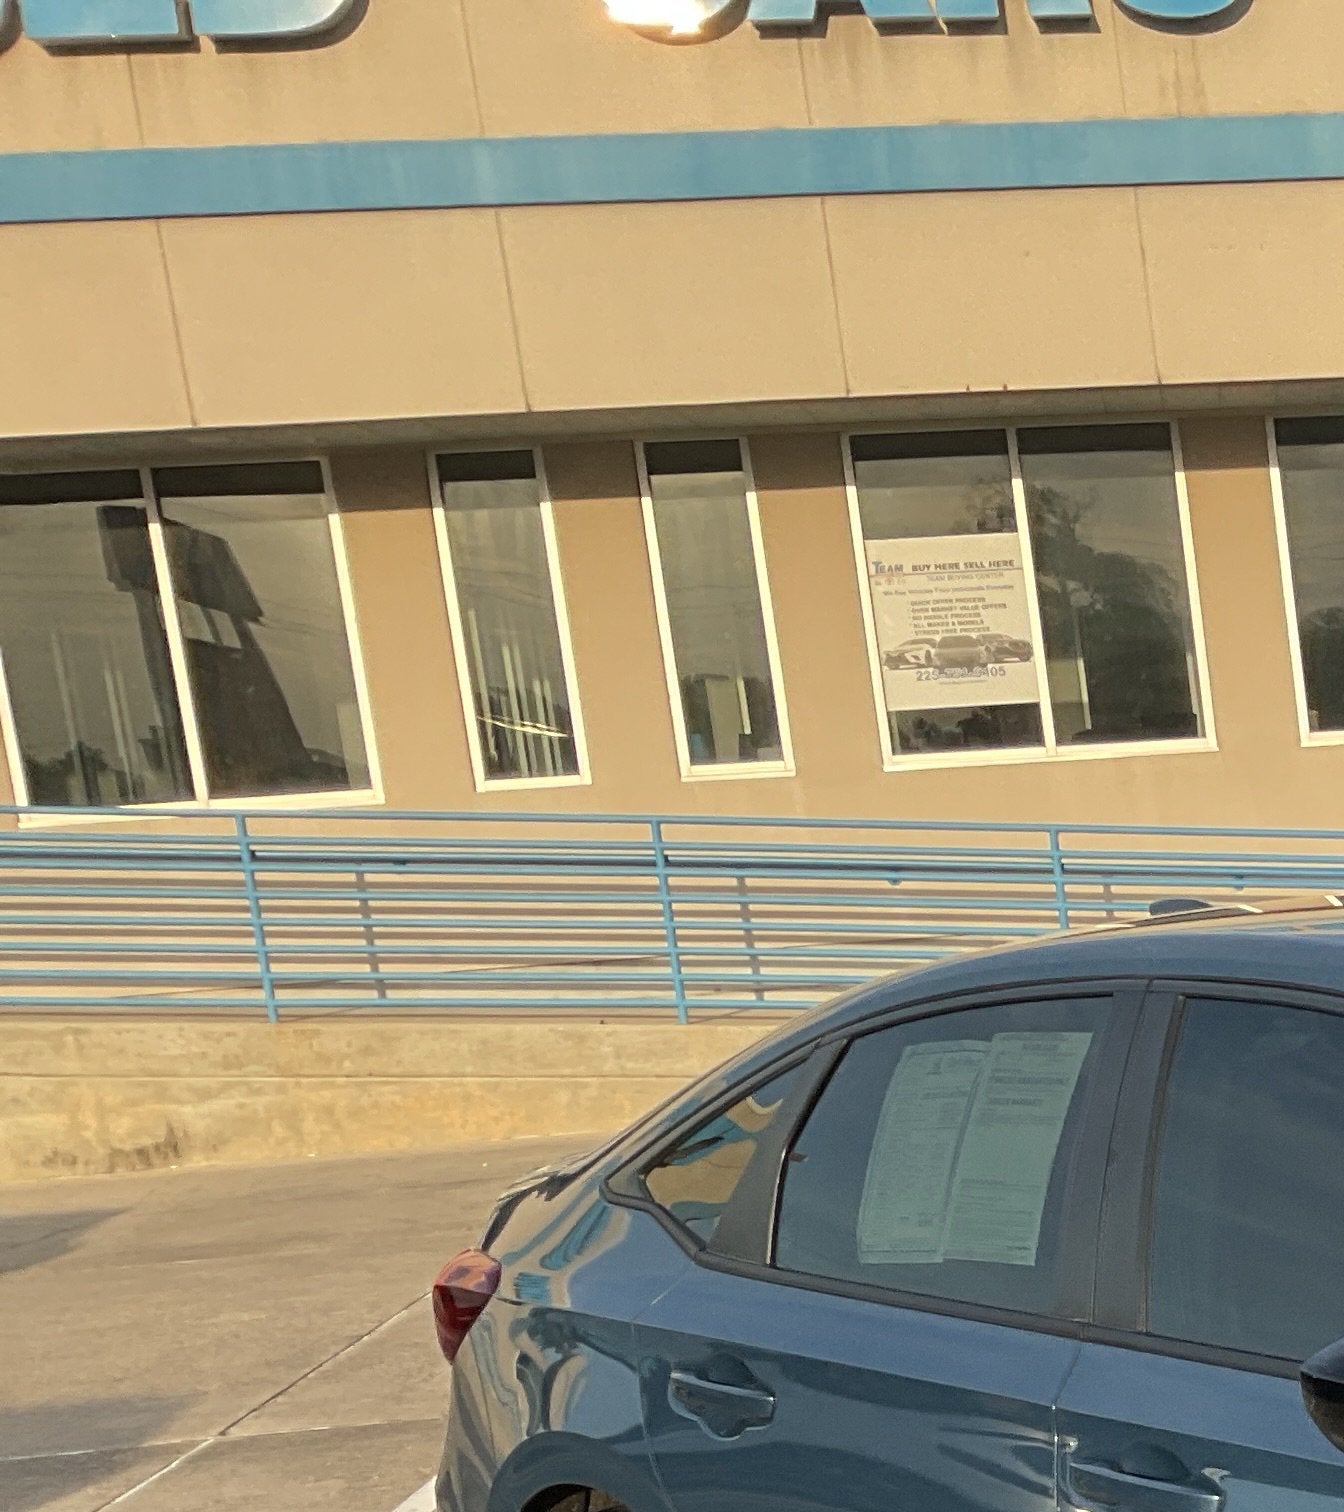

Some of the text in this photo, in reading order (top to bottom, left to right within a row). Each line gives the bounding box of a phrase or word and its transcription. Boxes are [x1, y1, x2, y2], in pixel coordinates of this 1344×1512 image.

[872, 560, 1015, 574] TEAM BUY HERE SELL HERE
